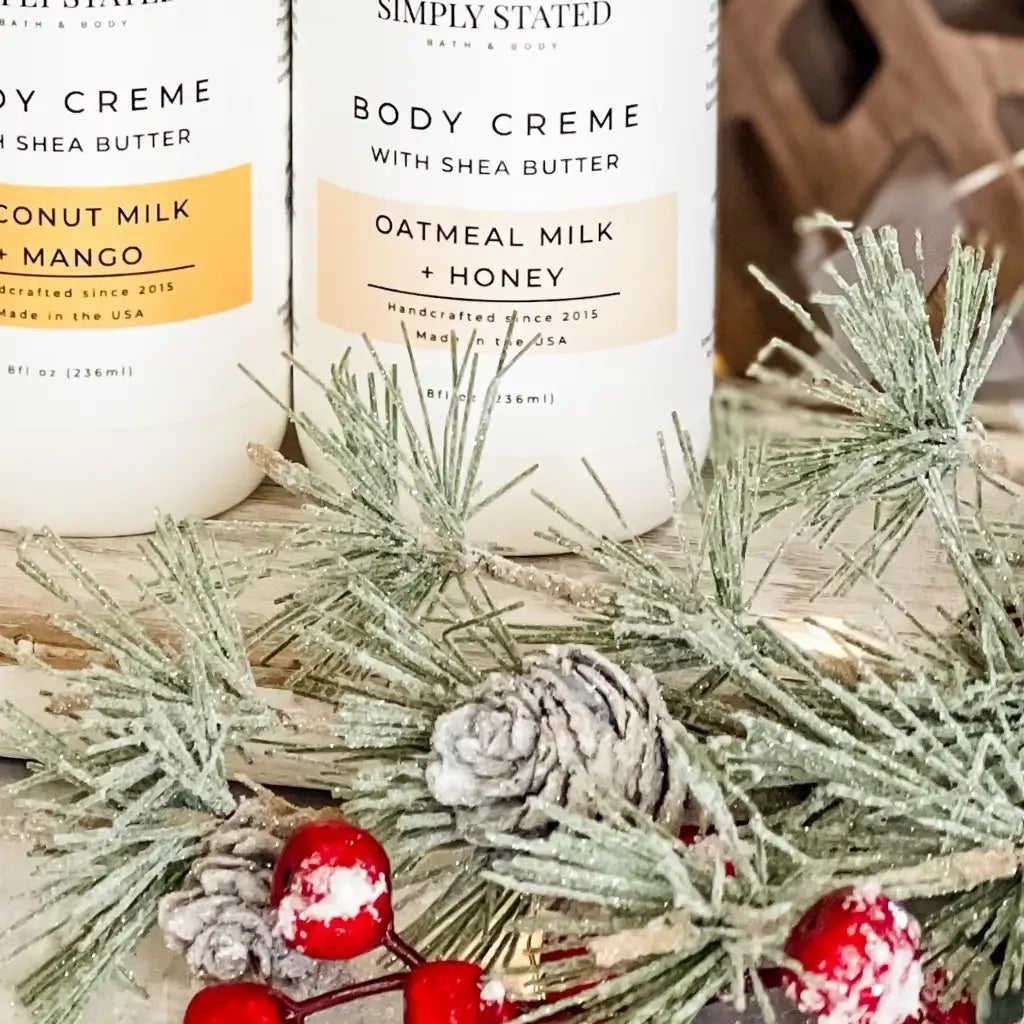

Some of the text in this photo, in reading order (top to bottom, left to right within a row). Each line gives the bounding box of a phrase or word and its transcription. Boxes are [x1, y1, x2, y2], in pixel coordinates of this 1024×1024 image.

[58, 20, 65, 29] &
[80, 19, 127, 29] BODY
[494, 1, 611, 29] STATED
[426, 38, 557, 51] BATH & BODY
[64, 78, 210, 114] CREME
[353, 95, 639, 137] BODY CREME
[16, 135, 84, 153] SHEA
[96, 128, 191, 153] BUTTER
[370, 145, 619, 176] WITH SHEA BUTTER
[117, 198, 190, 226] MILK
[375, 214, 613, 247] OATMEAL MILK
[23, 245, 143, 268] MANGO
[422, 265, 564, 288] + HONEY
[82, 287, 129, 299] since
[138, 281, 174, 295] 2015
[47, 311, 64, 321] in
[73, 311, 102, 322] the
[111, 308, 144, 321] USA
[388, 302, 599, 323] Handcrafted snce 2015
[496, 336, 524, 347] te
[7, 364, 133, 380] 8fl oz (236ml)
[427, 388, 449, 400] 8fl
[490, 393, 555, 405] 236ml)
